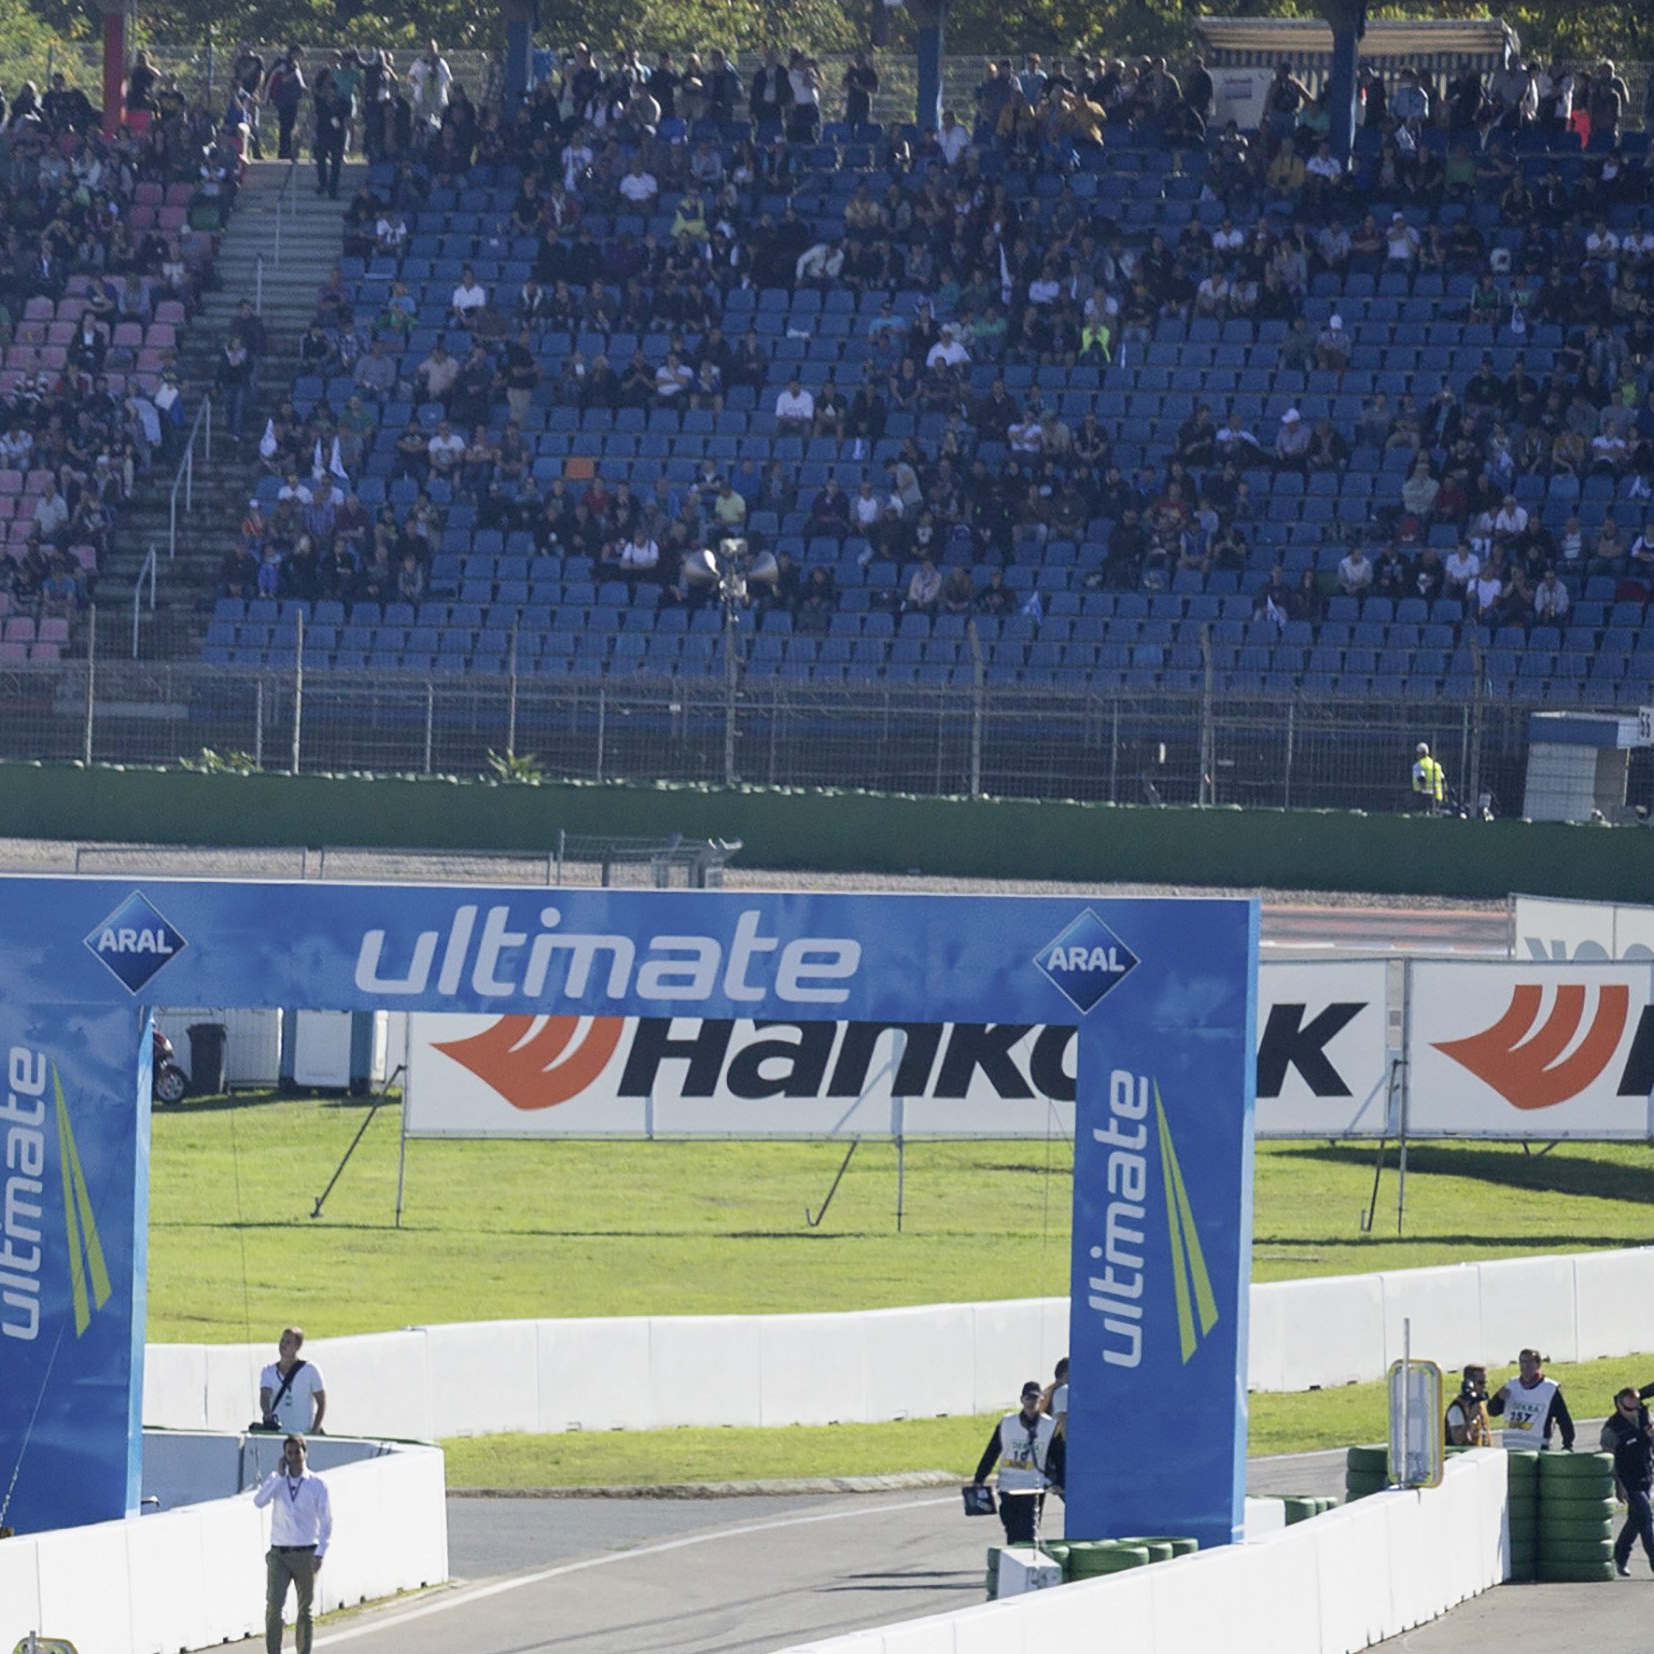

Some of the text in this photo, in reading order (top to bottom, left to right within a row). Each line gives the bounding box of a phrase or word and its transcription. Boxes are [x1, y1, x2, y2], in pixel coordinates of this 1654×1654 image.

[97, 926, 174, 956] ARAL
[355, 904, 863, 1004] ultimate
[1046, 945, 1126, 973] ARAL
[1088, 1069, 1149, 1368] ultimate
